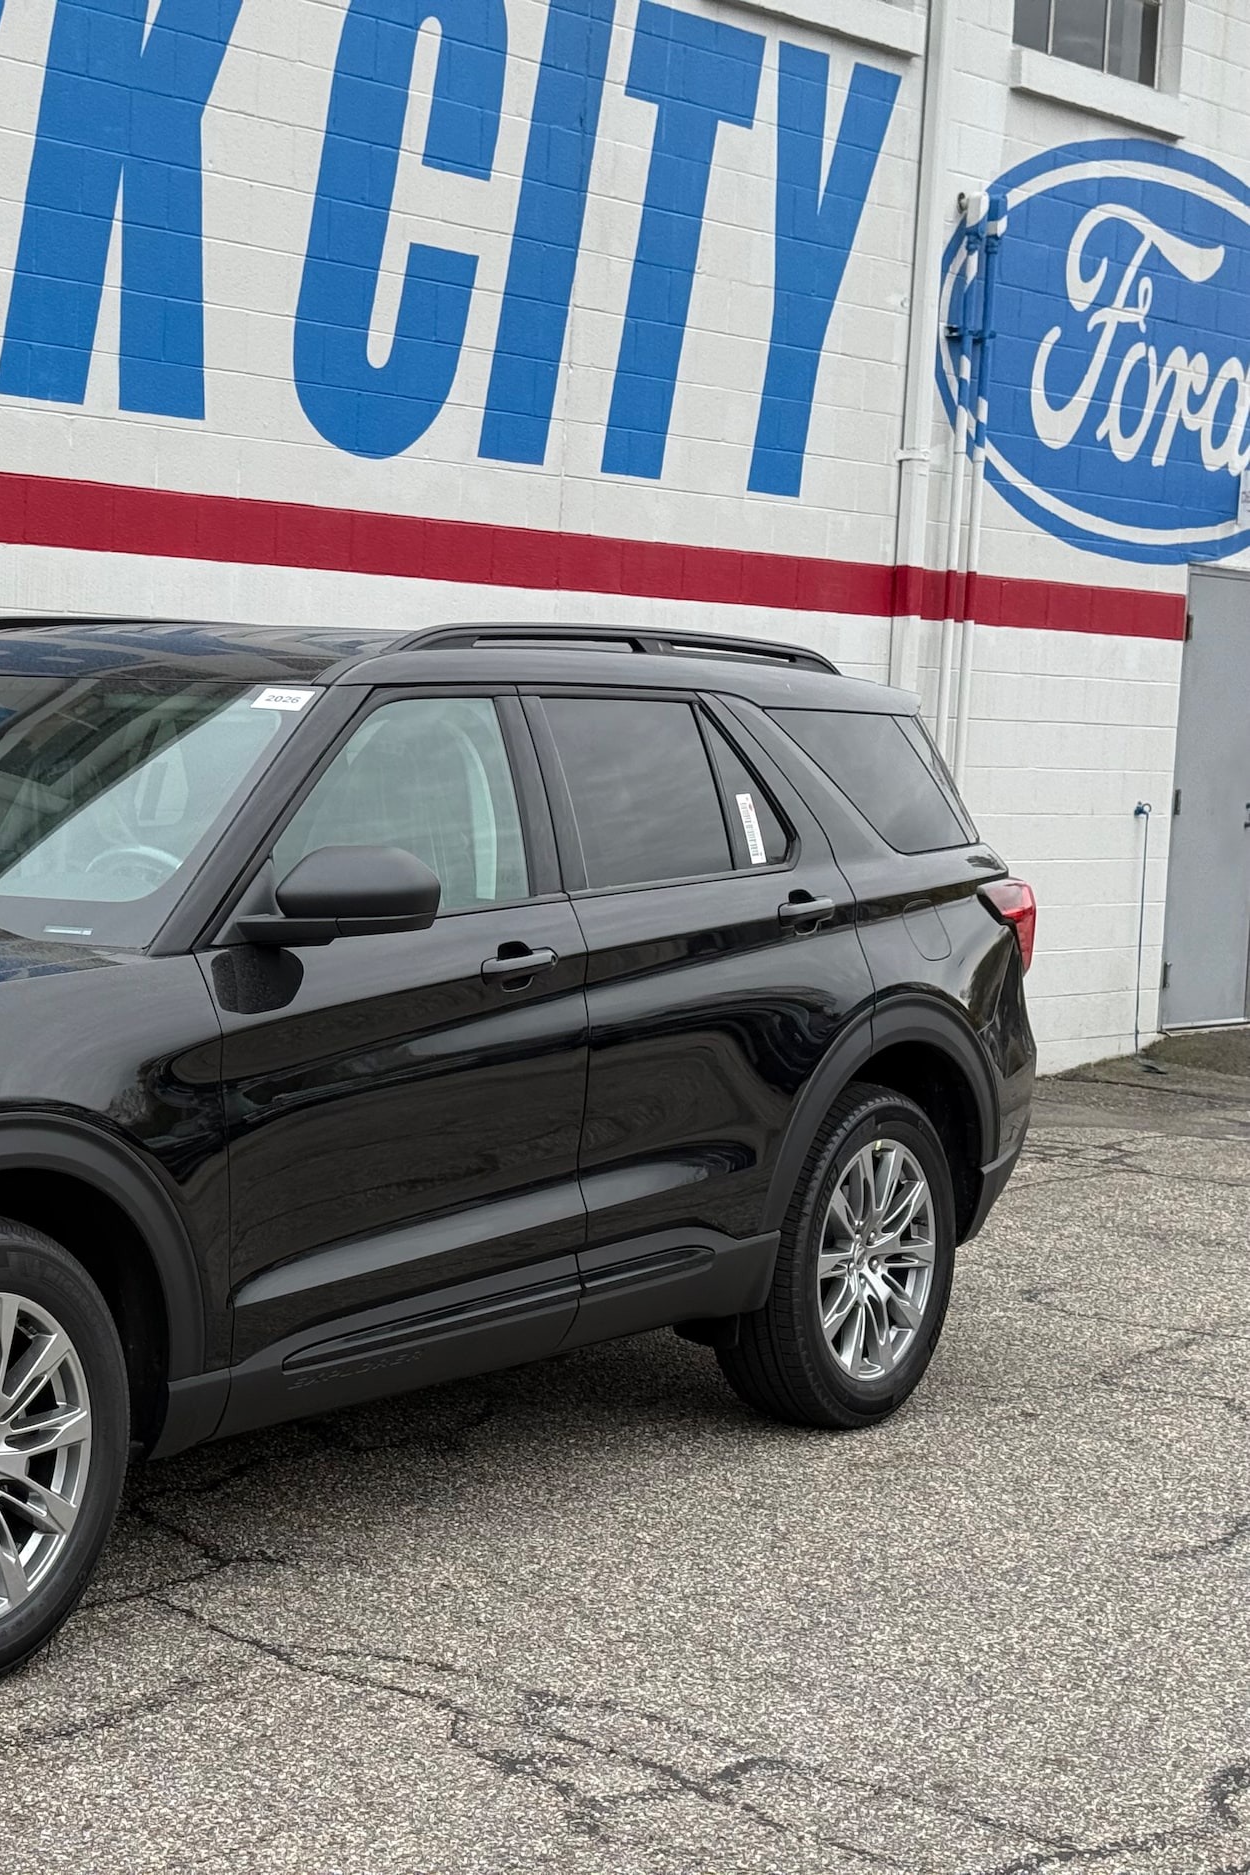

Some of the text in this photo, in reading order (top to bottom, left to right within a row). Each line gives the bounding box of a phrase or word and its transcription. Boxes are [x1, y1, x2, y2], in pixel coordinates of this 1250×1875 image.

[293, 0, 901, 497] CITY
[265, 695, 302, 704] 2026
[287, 1351, 423, 1390] EXPLORER
